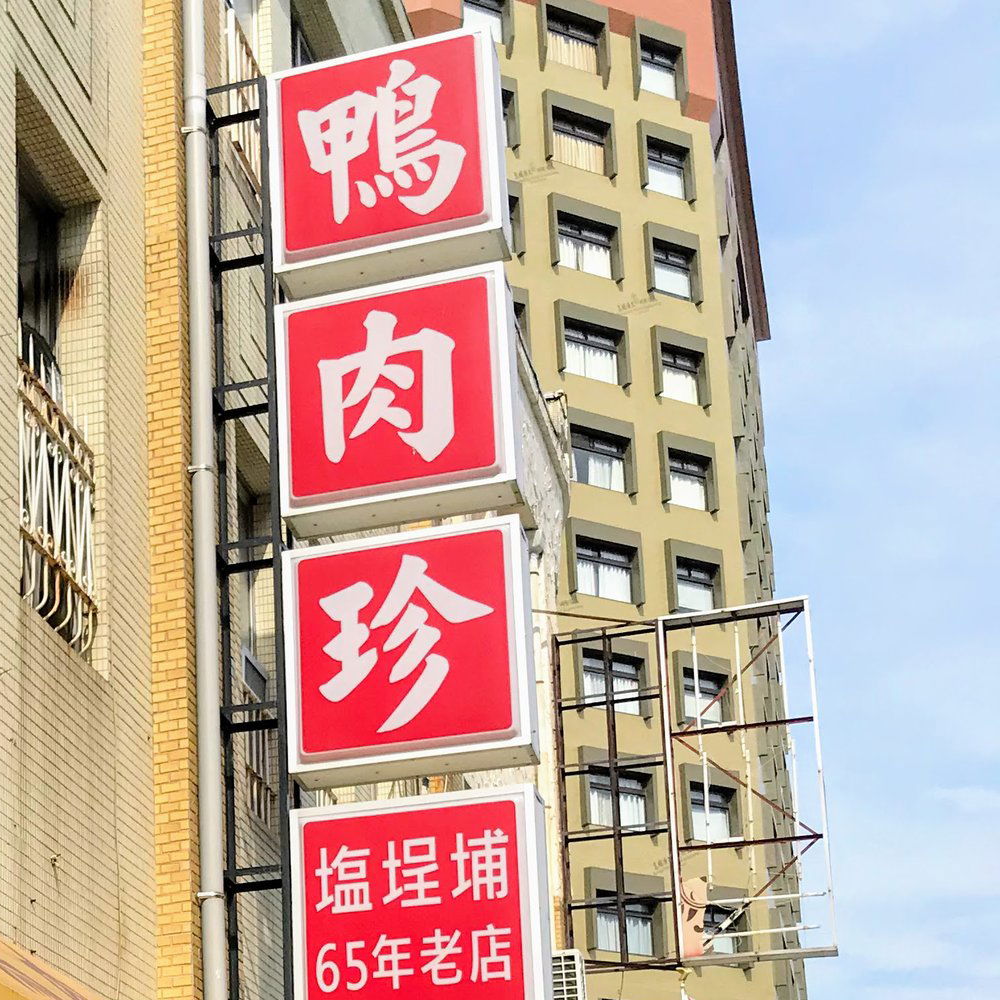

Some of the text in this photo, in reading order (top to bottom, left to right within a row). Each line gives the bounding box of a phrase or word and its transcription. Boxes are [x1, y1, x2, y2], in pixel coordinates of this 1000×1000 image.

[314, 827, 509, 915] 塩埕埔
[314, 922, 512, 994] 65年老店
